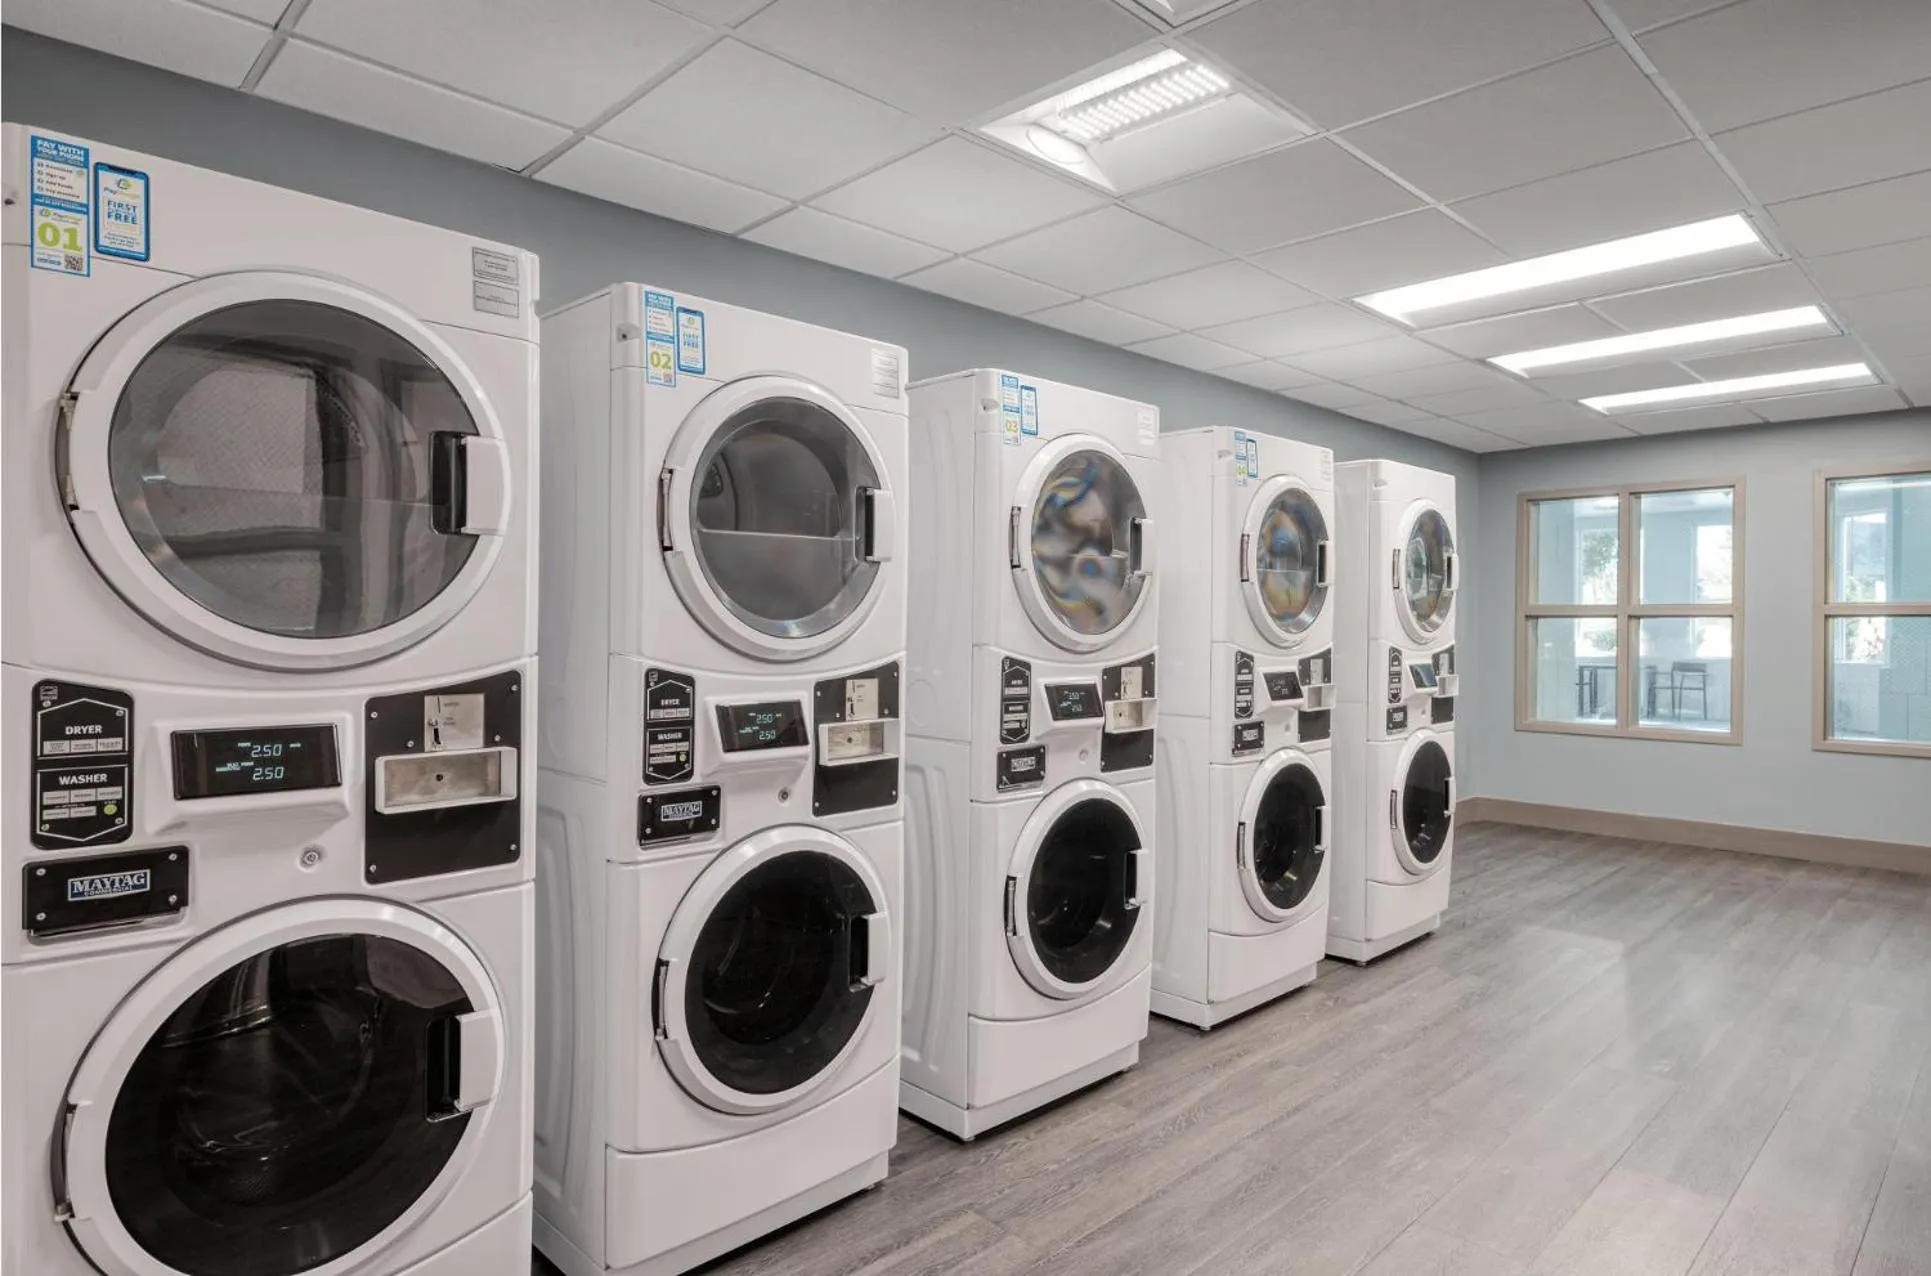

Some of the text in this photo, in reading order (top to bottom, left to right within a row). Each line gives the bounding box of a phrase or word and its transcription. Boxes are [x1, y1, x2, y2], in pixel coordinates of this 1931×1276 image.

[58, 144, 84, 155] WITH
[107, 200, 137, 213] FIRST
[107, 212, 137, 224] FREE
[38, 222, 82, 252] 01
[650, 351, 671, 370] 02
[65, 724, 103, 735] DRYER
[251, 744, 282, 757] 2.50
[59, 773, 108, 785] WASHER
[252, 766, 285, 780] 2.50
[663, 803, 700, 815] MAYTAG
[72, 872, 145, 893] MAYTAG
